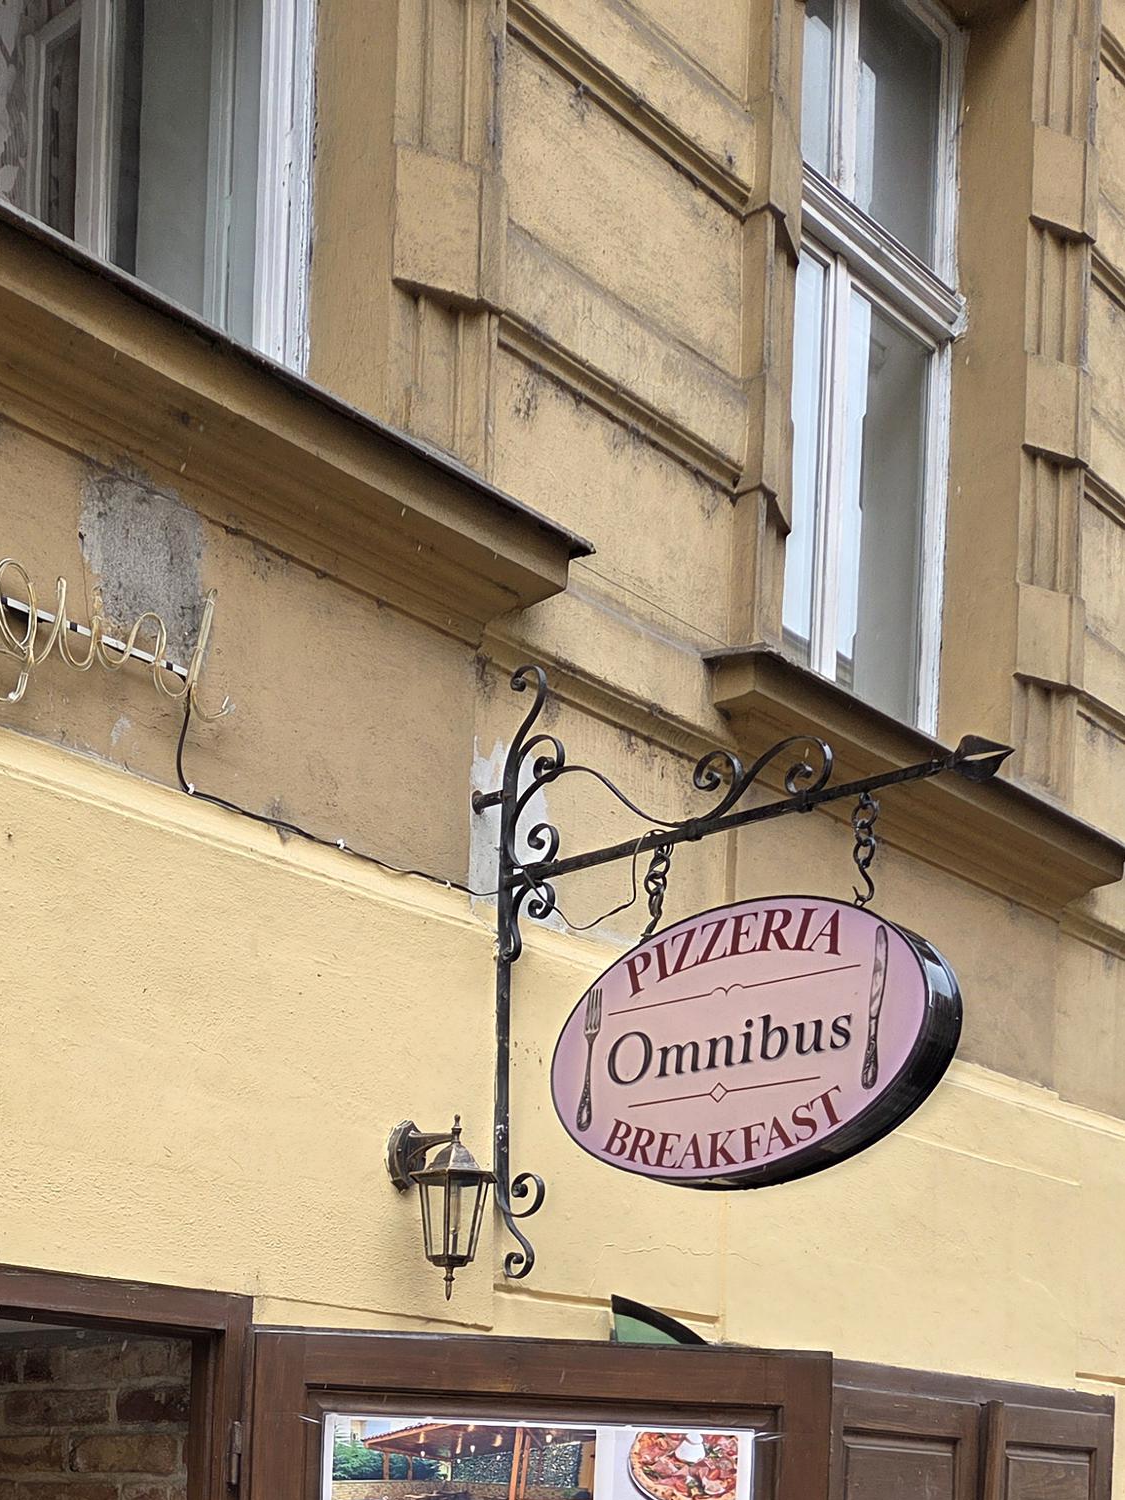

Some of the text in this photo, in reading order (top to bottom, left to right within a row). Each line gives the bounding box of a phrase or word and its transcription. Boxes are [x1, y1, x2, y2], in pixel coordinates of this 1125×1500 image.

[623, 907, 843, 997] PIZZERIA
[607, 1012, 854, 1085] Omnibus
[602, 1085, 846, 1169] BREAKFAST
